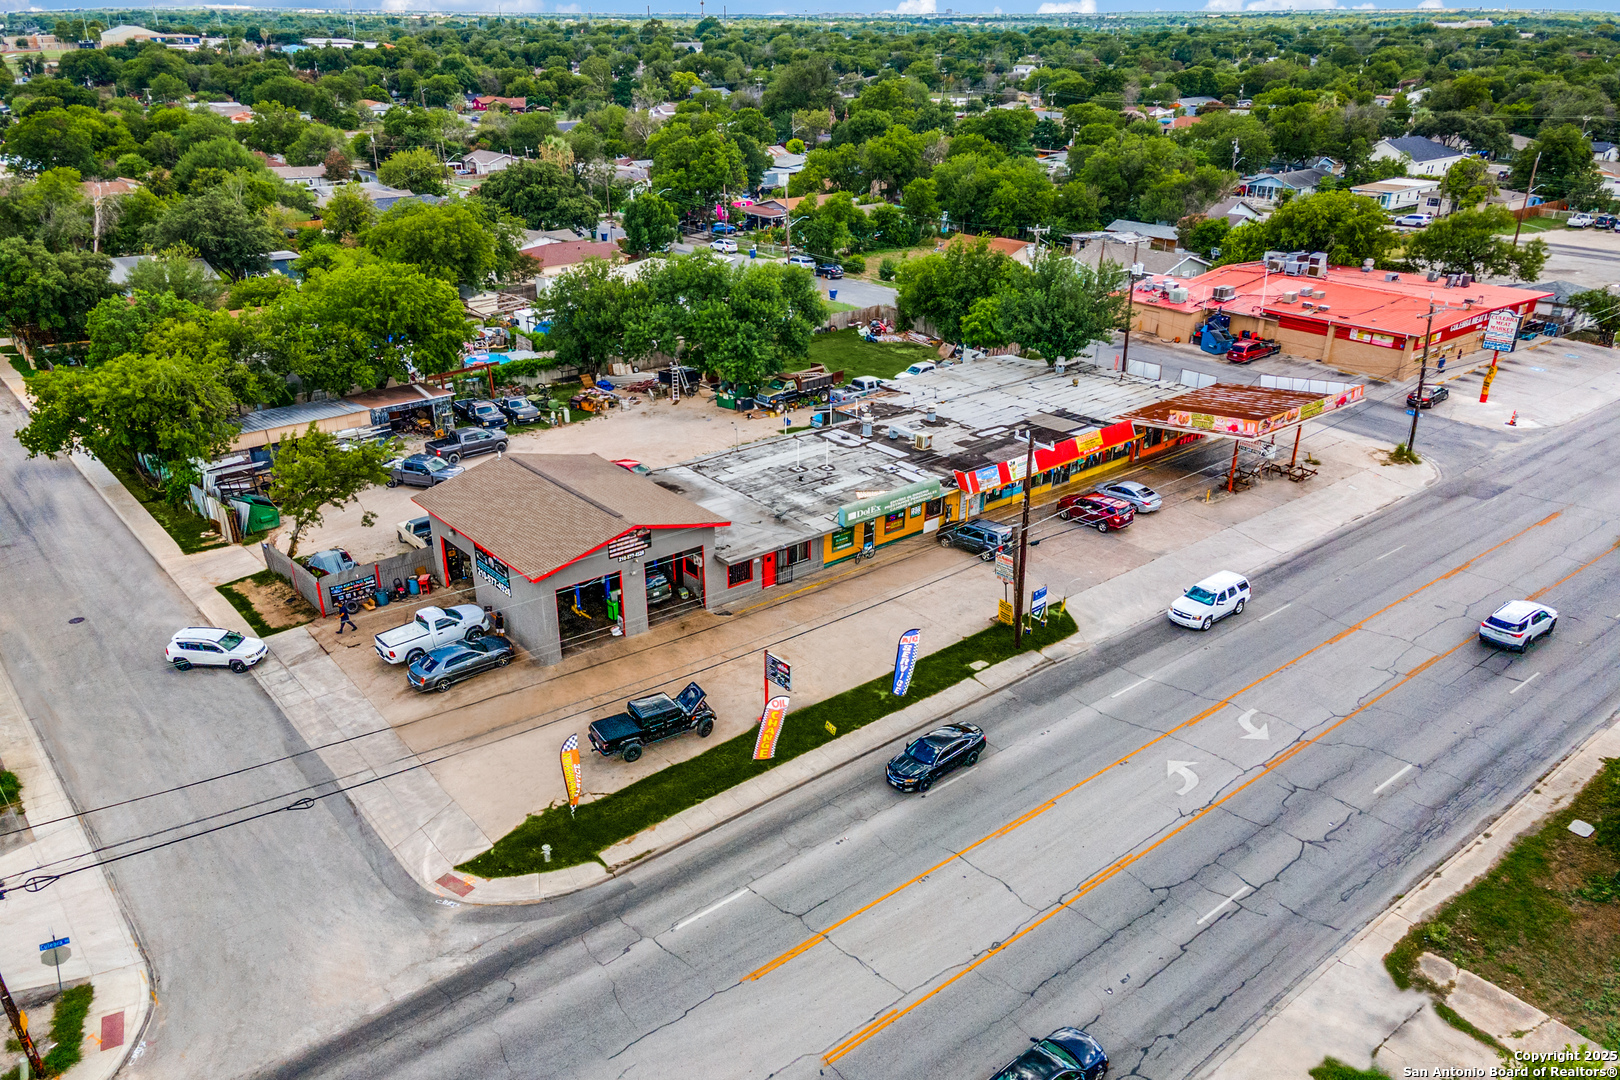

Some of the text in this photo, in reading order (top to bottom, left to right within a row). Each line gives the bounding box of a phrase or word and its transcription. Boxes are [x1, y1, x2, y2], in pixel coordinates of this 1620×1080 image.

[1491, 315, 1518, 323] CULEBRA
[1491, 325, 1514, 333] MARKET
[857, 505, 881, 517] DolEx
[902, 635, 918, 644] A/C
[893, 644, 913, 695] SERVICE
[771, 699, 787, 708] OIL
[759, 711, 780, 758] CHANGE
